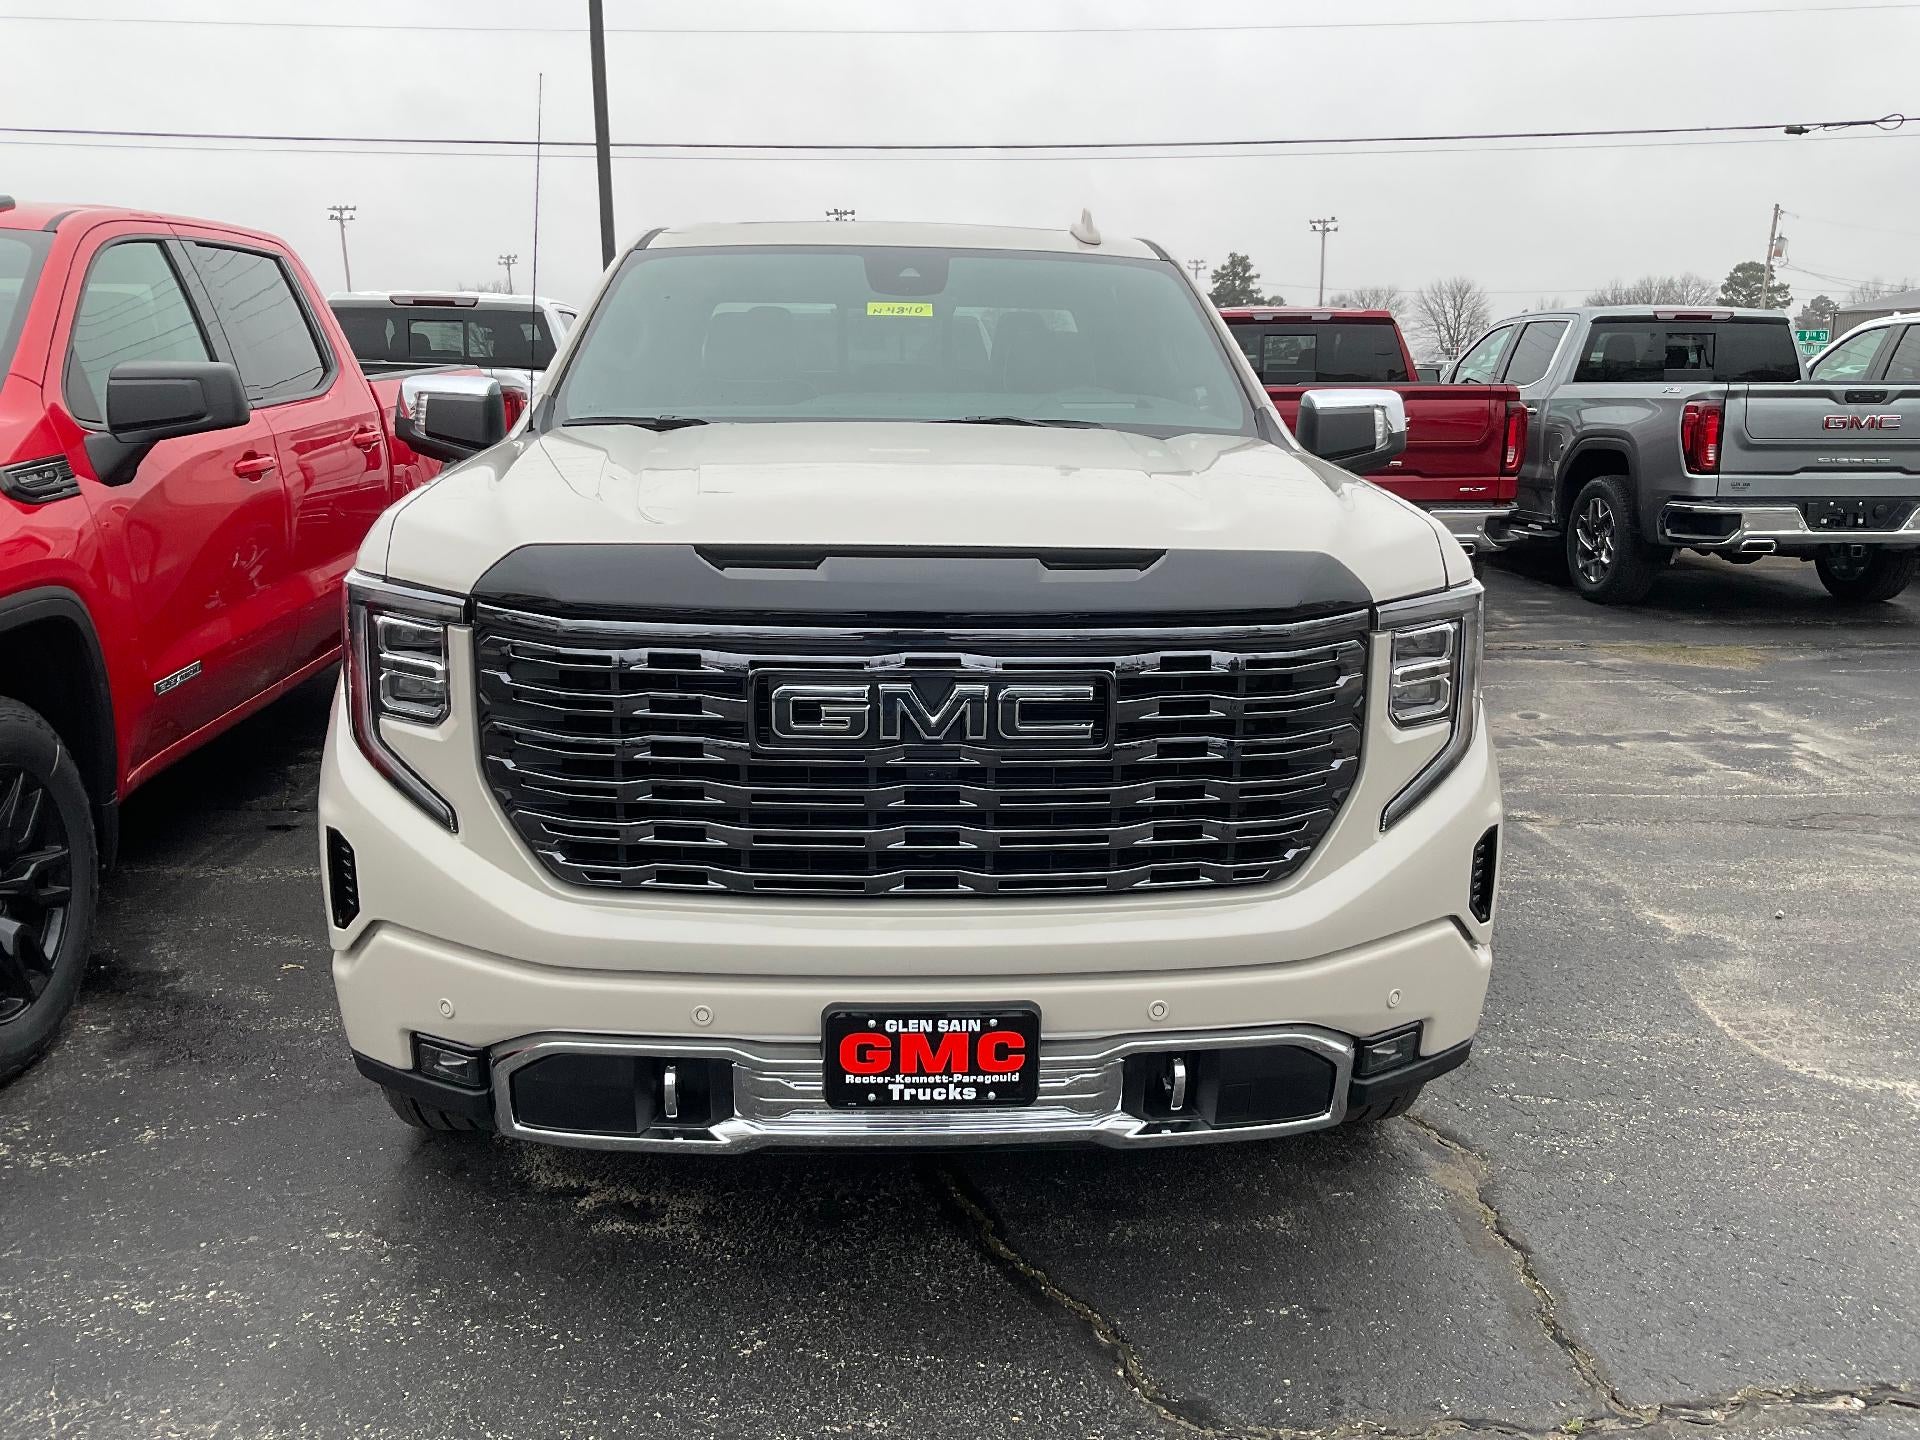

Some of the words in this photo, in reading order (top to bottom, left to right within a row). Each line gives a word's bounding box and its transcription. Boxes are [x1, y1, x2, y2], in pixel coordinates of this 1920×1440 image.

[1823, 414, 1902, 430] GMC
[771, 683, 1095, 740] GMC
[885, 1019, 933, 1032] GLEN
[937, 1018, 981, 1032] SAIN
[839, 1031, 1026, 1073] GMC
[845, 1073, 1020, 1084] Rector-Kennett-Paragould
[888, 1083, 977, 1100] Trucks
